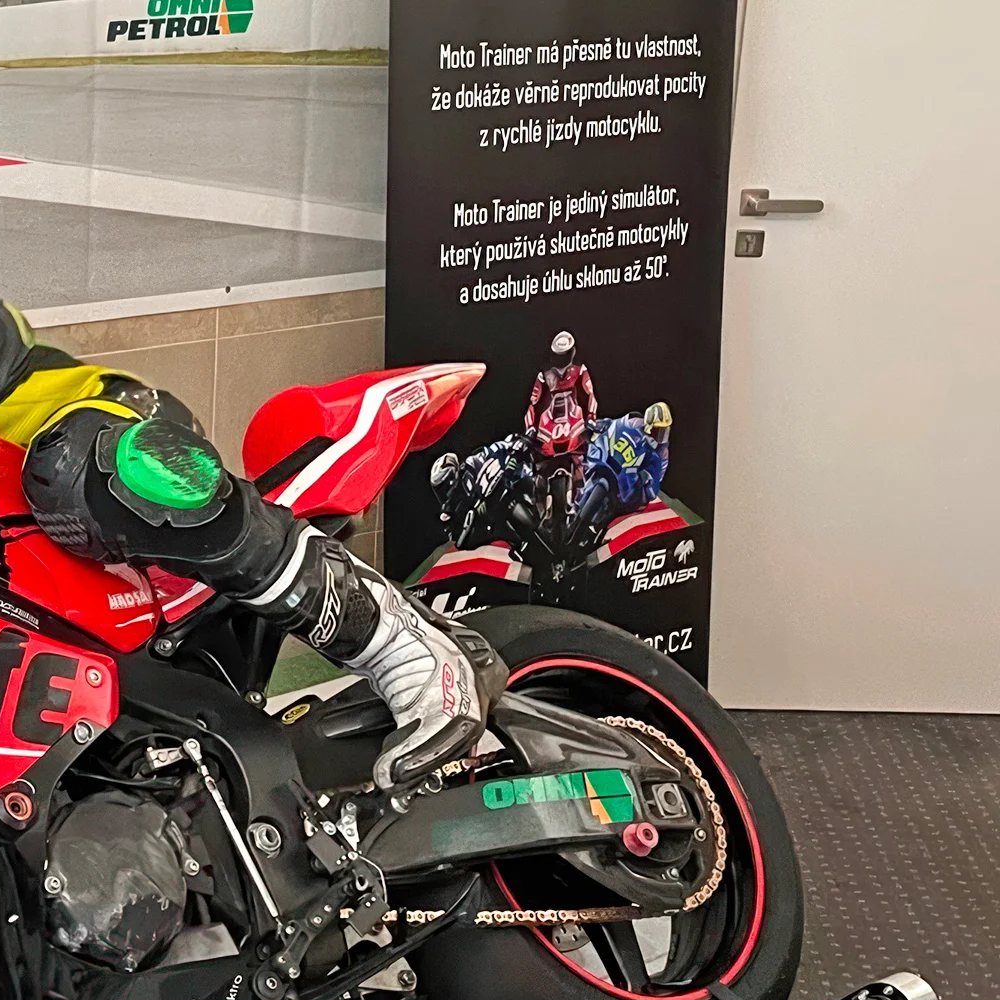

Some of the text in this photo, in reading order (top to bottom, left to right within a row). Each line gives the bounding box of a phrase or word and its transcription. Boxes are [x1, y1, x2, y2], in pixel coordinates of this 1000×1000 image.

[107, 15, 220, 42] PETROL
[147, 0, 219, 16] OMNI
[439, 33, 701, 70] Moto Trainer má přesně tu vlastnost,
[431, 71, 706, 111] že dokáže věrně reprodukovat pocity
[479, 129, 489, 147] z
[493, 119, 542, 152] rychlé
[586, 110, 661, 141] motocyklu.
[453, 184, 680, 228] Moto Trainer je jediný simulátor,
[440, 217, 689, 270] který používá skutečně motocykly
[459, 286, 469, 304] a
[472, 275, 538, 302] dosahuje
[542, 269, 572, 293] úhlu
[575, 264, 621, 288] sklonu
[623, 260, 641, 282] až
[630, 566, 698, 593] TRAINER
[308, 562, 341, 648] RST
